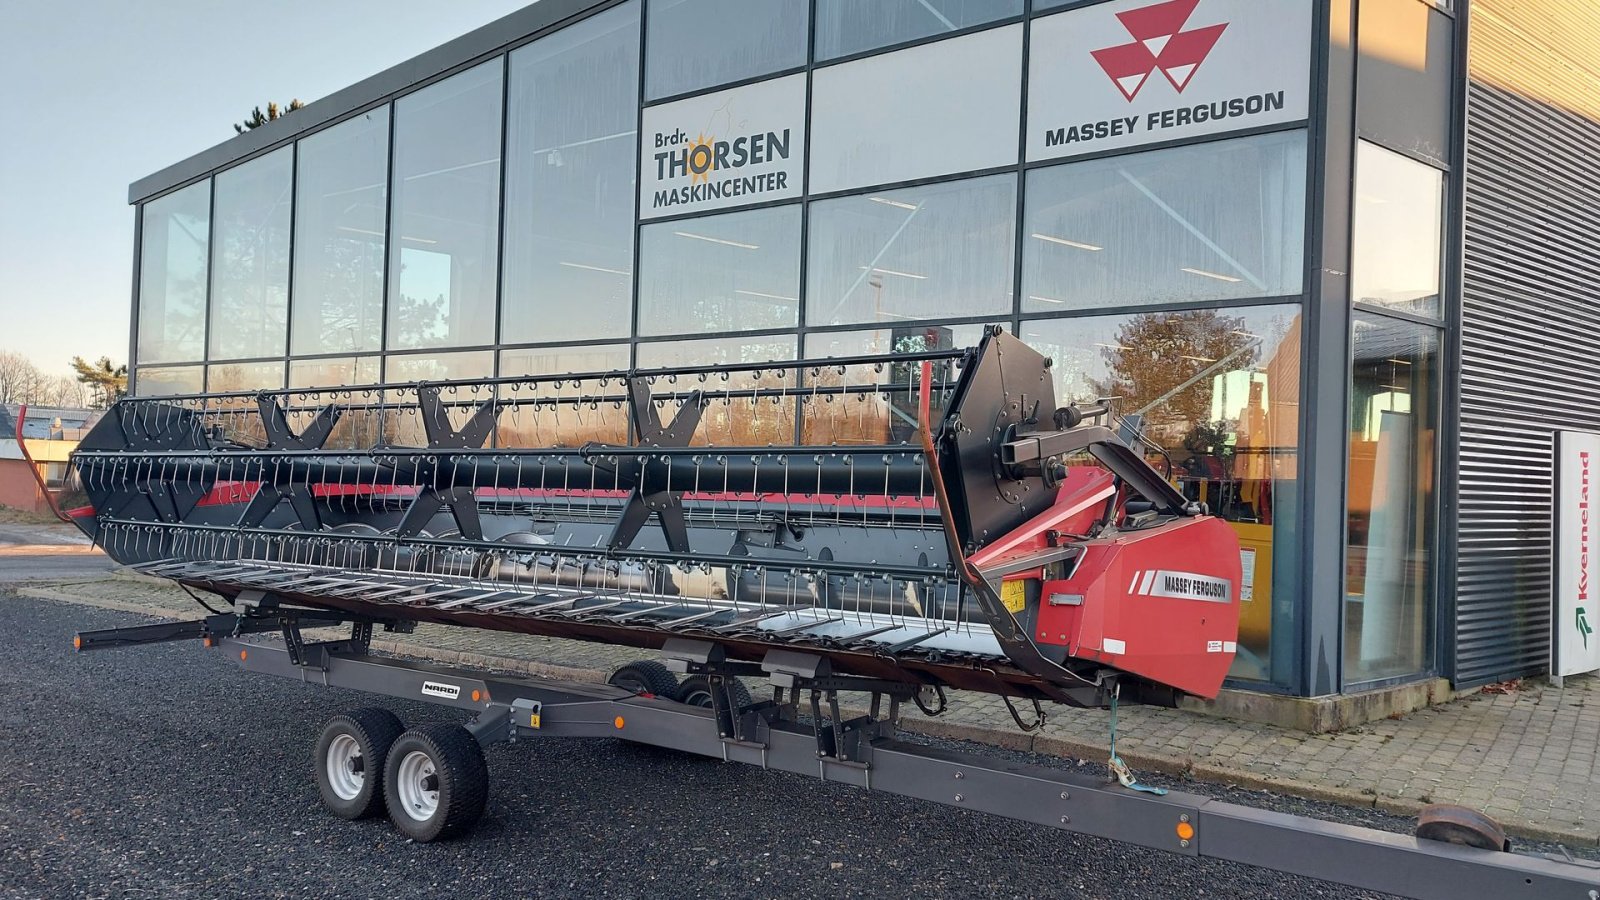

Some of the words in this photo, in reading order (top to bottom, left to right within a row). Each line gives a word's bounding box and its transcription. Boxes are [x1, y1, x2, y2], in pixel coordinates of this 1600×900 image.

[1045, 115, 1139, 147] MASSEY
[1147, 90, 1285, 131] FERGUSON
[654, 128, 790, 181] THORSEN
[655, 128, 689, 148] Brdr.
[653, 171, 788, 208] MASKINCENTER
[1578, 451, 1589, 600] Kverneland
[1164, 575, 1192, 594] MASSEY
[1192, 579, 1226, 598] FERGUSON
[424, 684, 458, 695] NARDI
